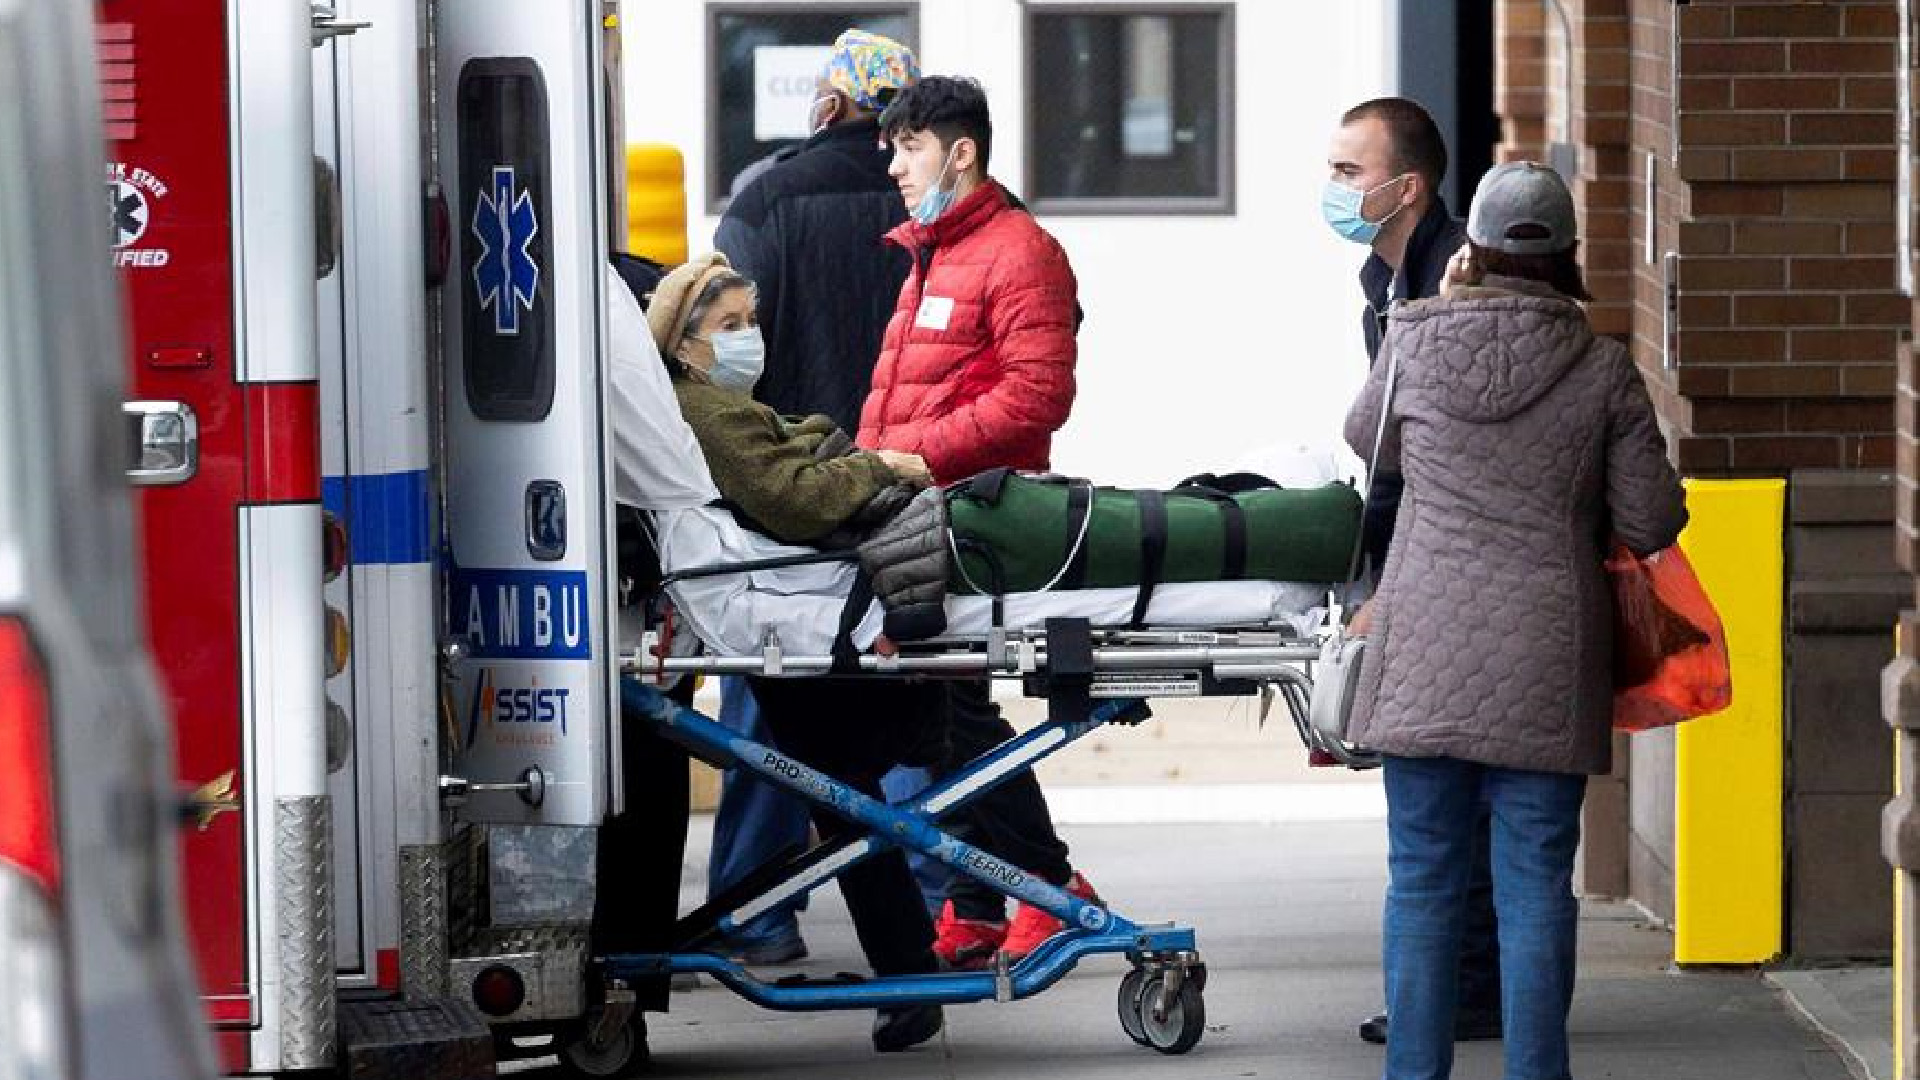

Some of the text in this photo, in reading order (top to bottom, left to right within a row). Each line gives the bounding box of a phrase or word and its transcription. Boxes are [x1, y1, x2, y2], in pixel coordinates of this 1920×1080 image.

[767, 75, 813, 96] CLO
[132, 167, 168, 198] STATE
[113, 248, 169, 267] IFIED
[466, 584, 581, 648] AMBU
